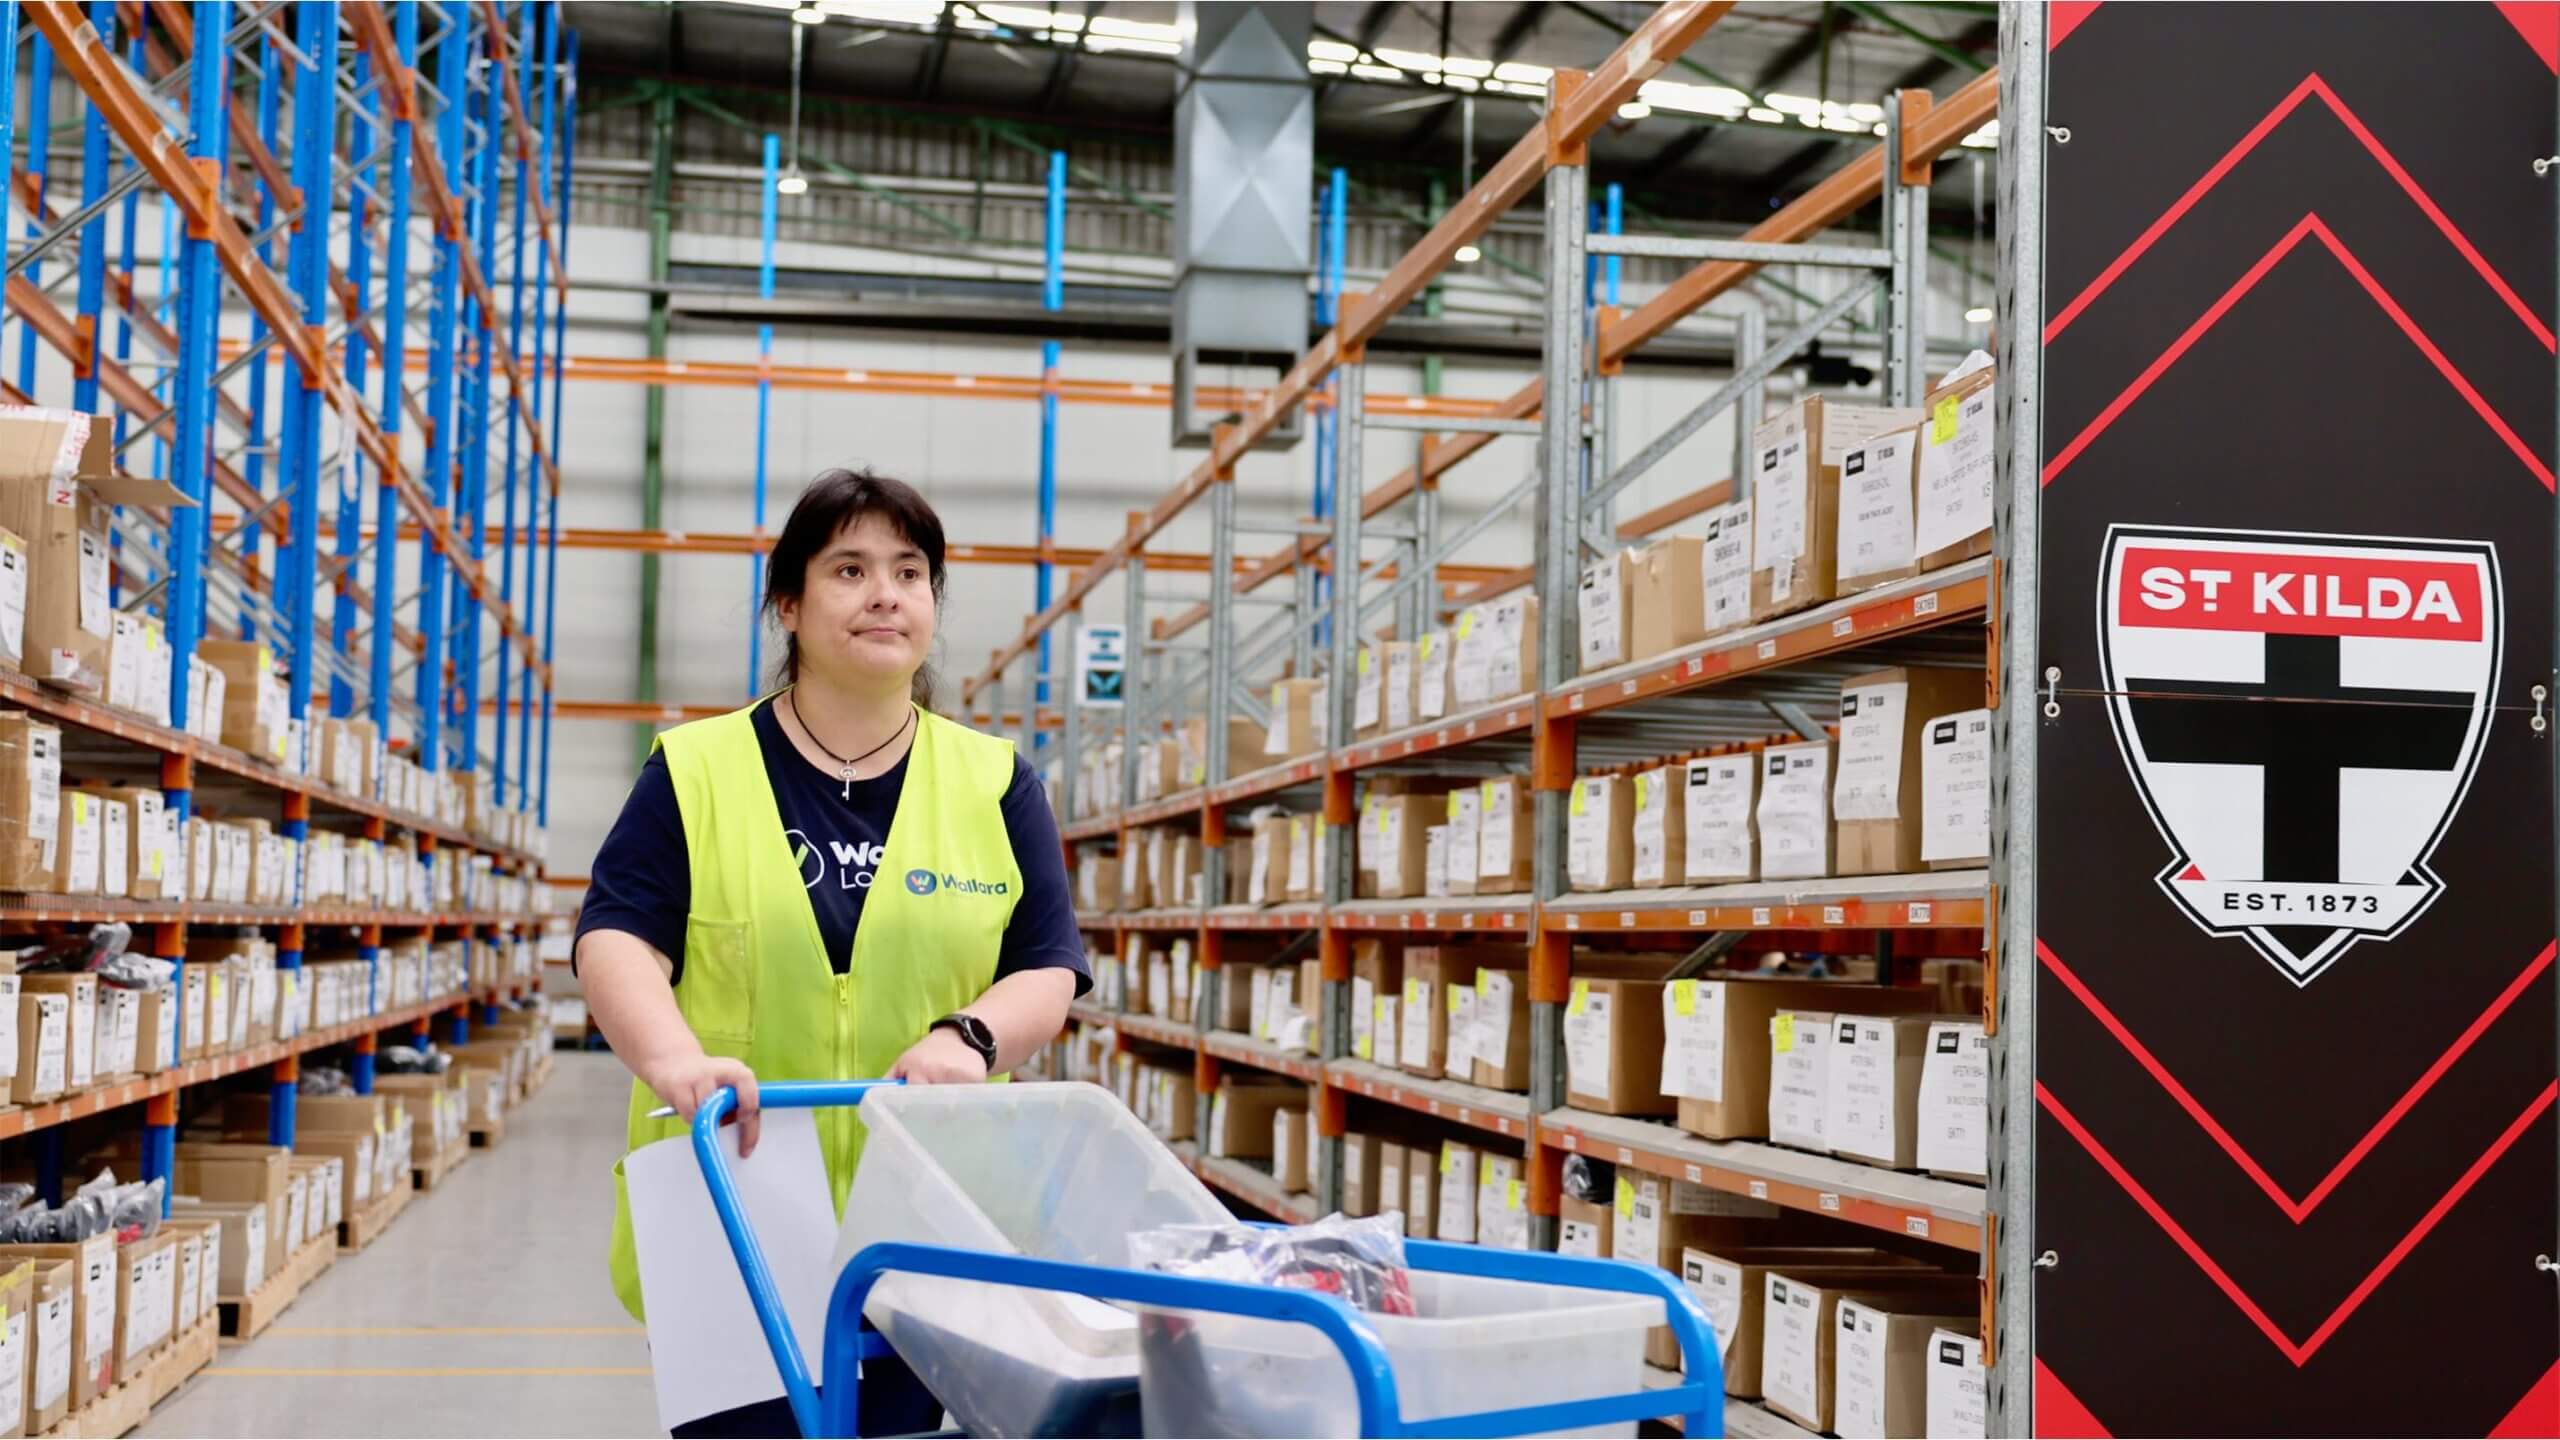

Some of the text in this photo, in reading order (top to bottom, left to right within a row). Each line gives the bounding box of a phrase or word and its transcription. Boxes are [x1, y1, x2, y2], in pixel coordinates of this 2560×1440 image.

[2253, 572, 2463, 623] KILDA
[941, 872, 1008, 895] Wallara
[2223, 892, 2378, 913] EST. 1873
